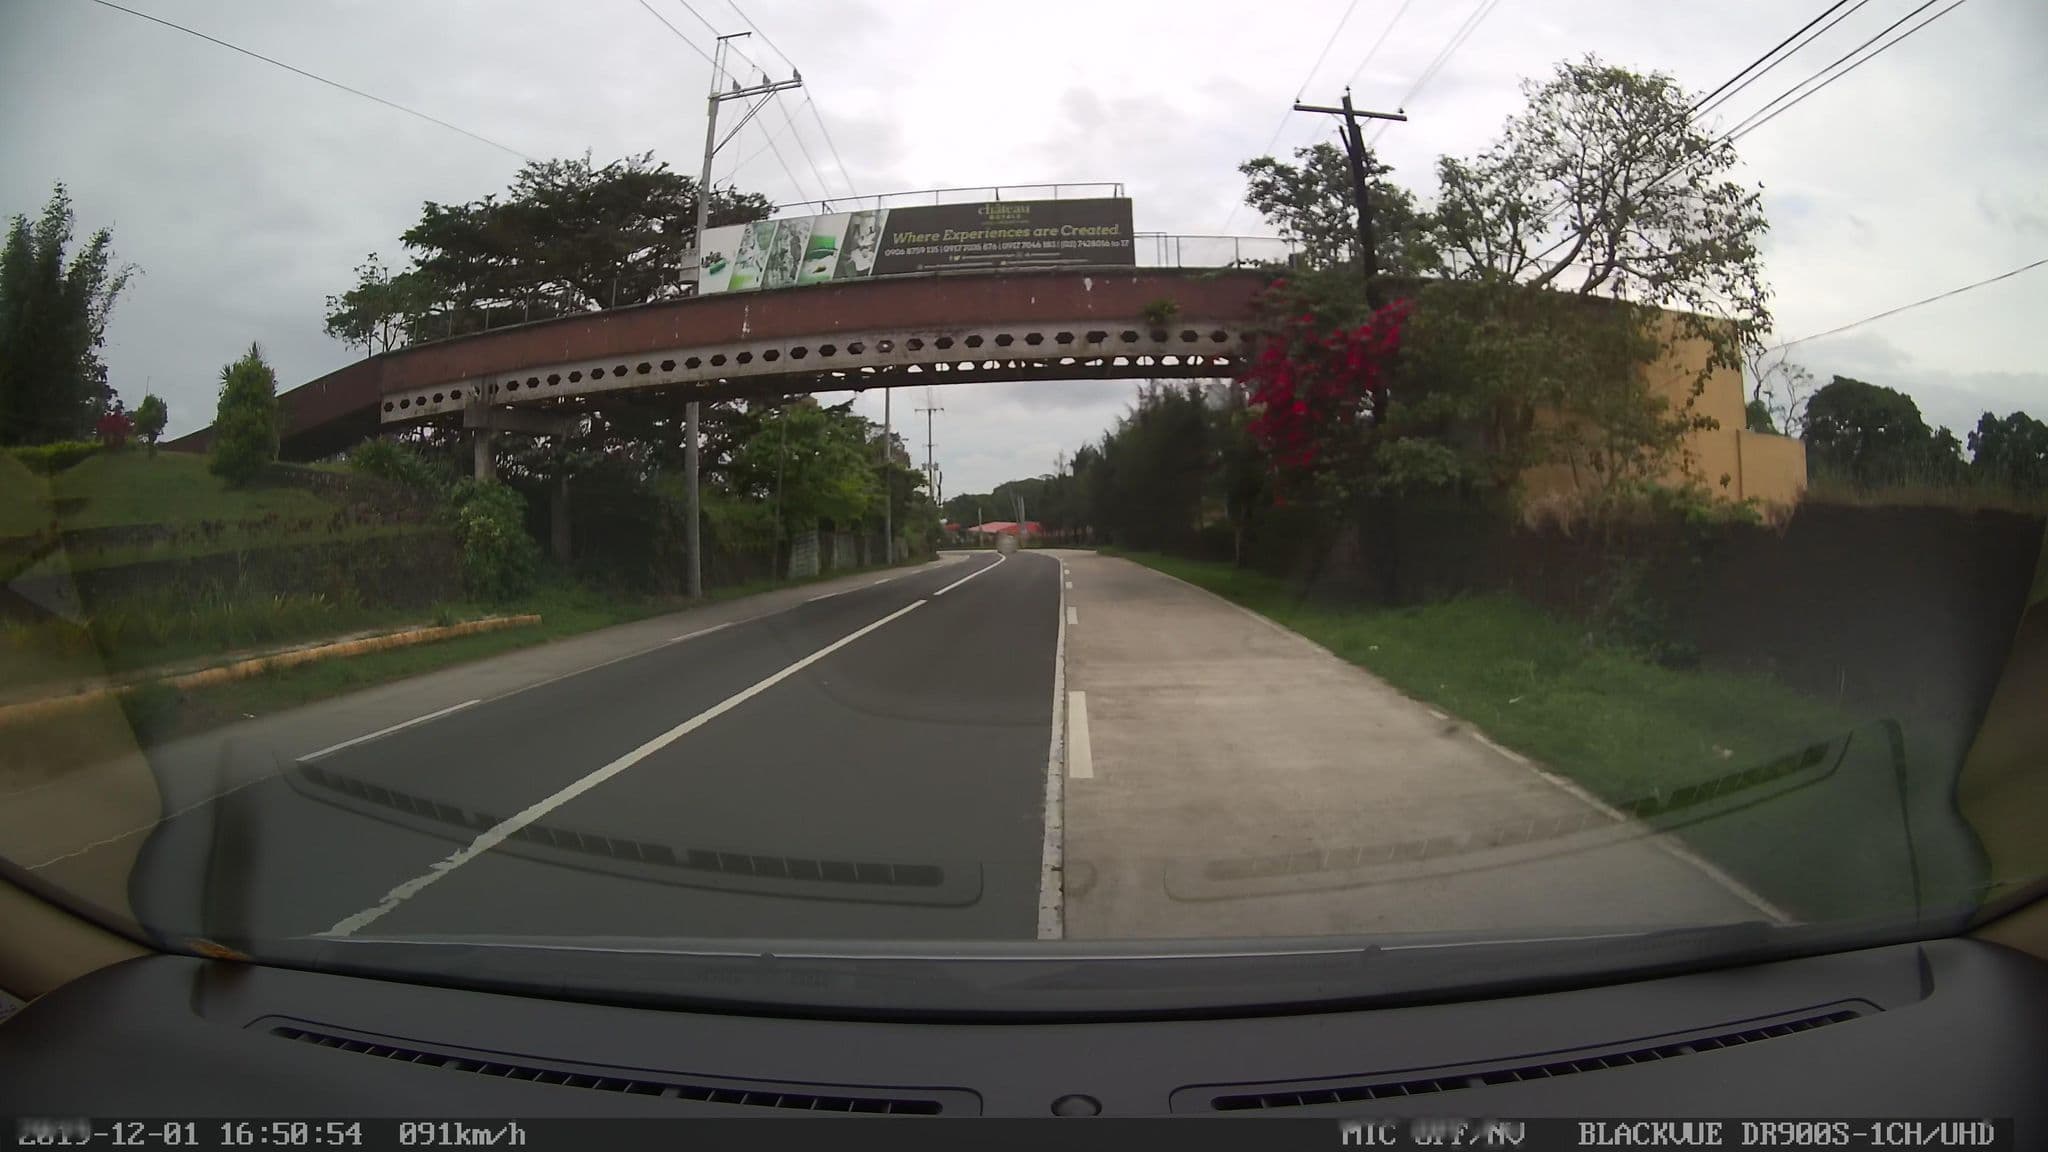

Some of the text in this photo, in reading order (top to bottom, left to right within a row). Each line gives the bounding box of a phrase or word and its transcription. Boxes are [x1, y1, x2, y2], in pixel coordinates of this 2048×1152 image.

[893, 232, 940, 244] Where
[943, 229, 1031, 242] Experiences
[1034, 228, 1058, 237] are
